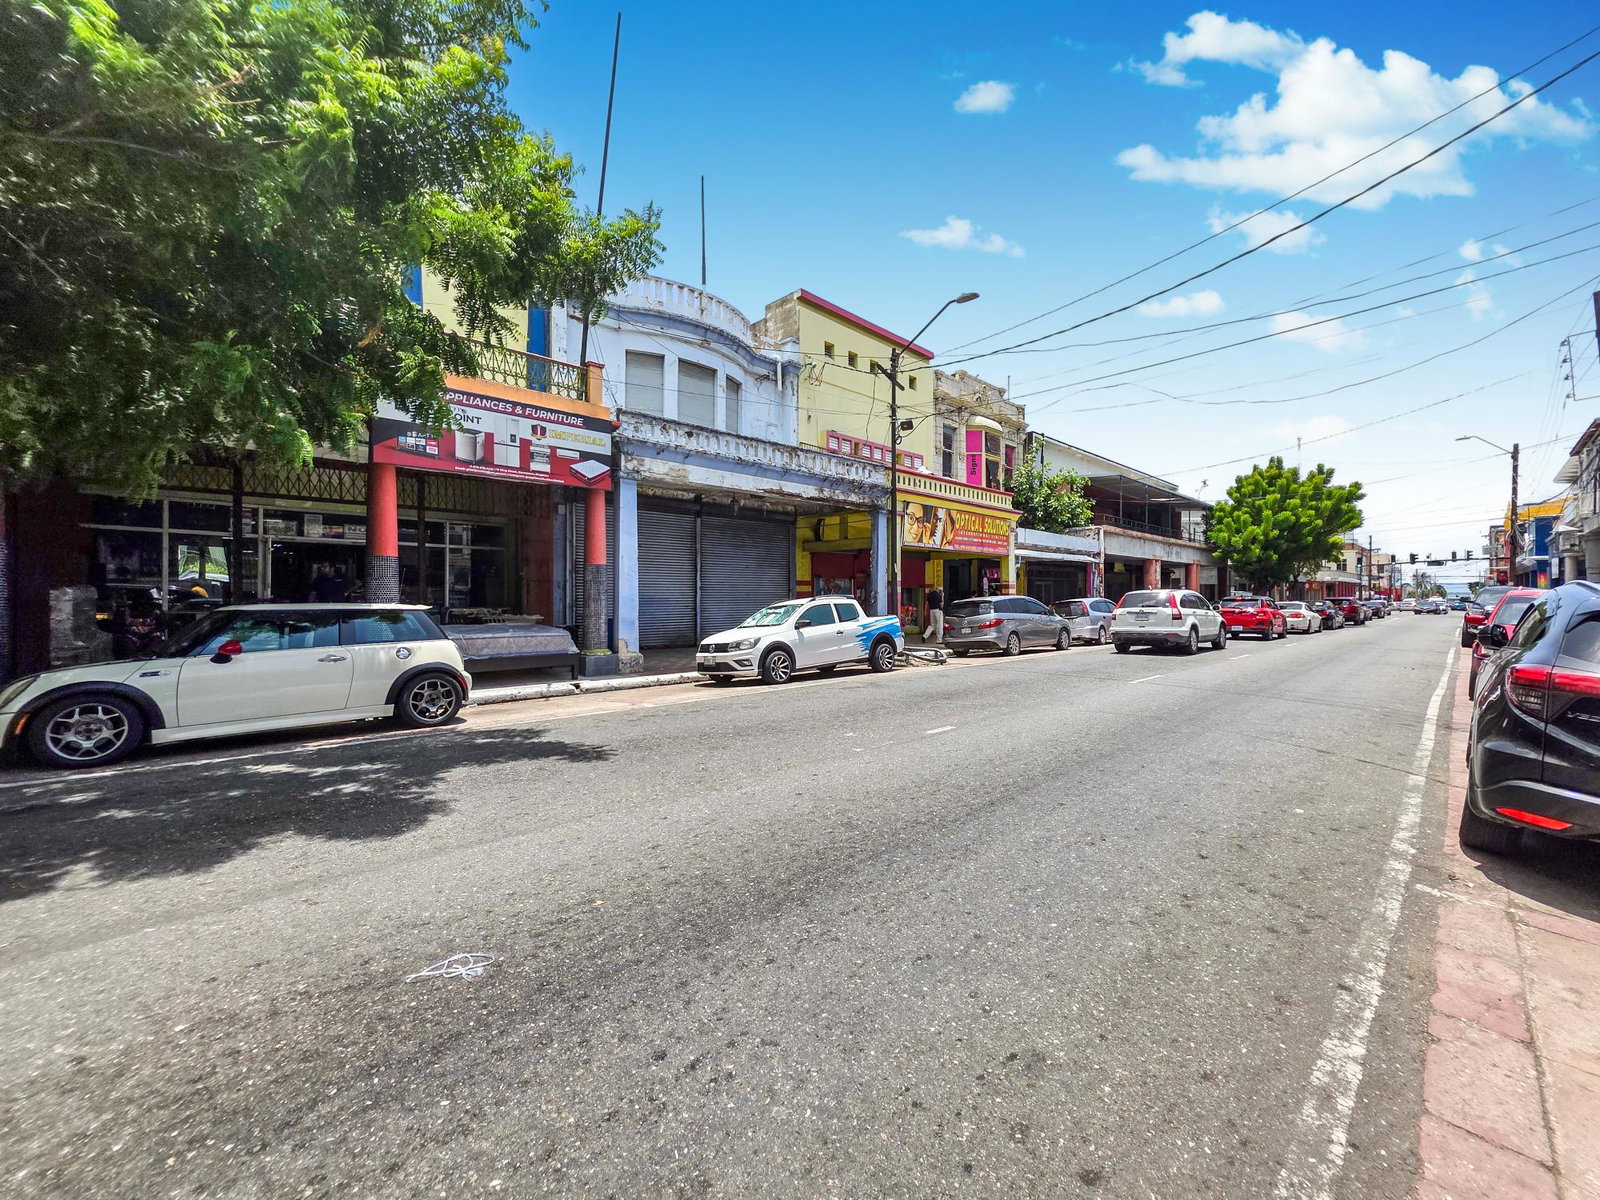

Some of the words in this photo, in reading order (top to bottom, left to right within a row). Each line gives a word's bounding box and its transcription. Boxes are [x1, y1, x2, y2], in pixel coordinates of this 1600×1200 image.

[453, 413, 482, 425] OINT
[515, 405, 523, 415] &
[525, 407, 585, 426] FURNITURE
[955, 512, 983, 533] OPTICAL
[984, 517, 1010, 536] SOLUTIONS
